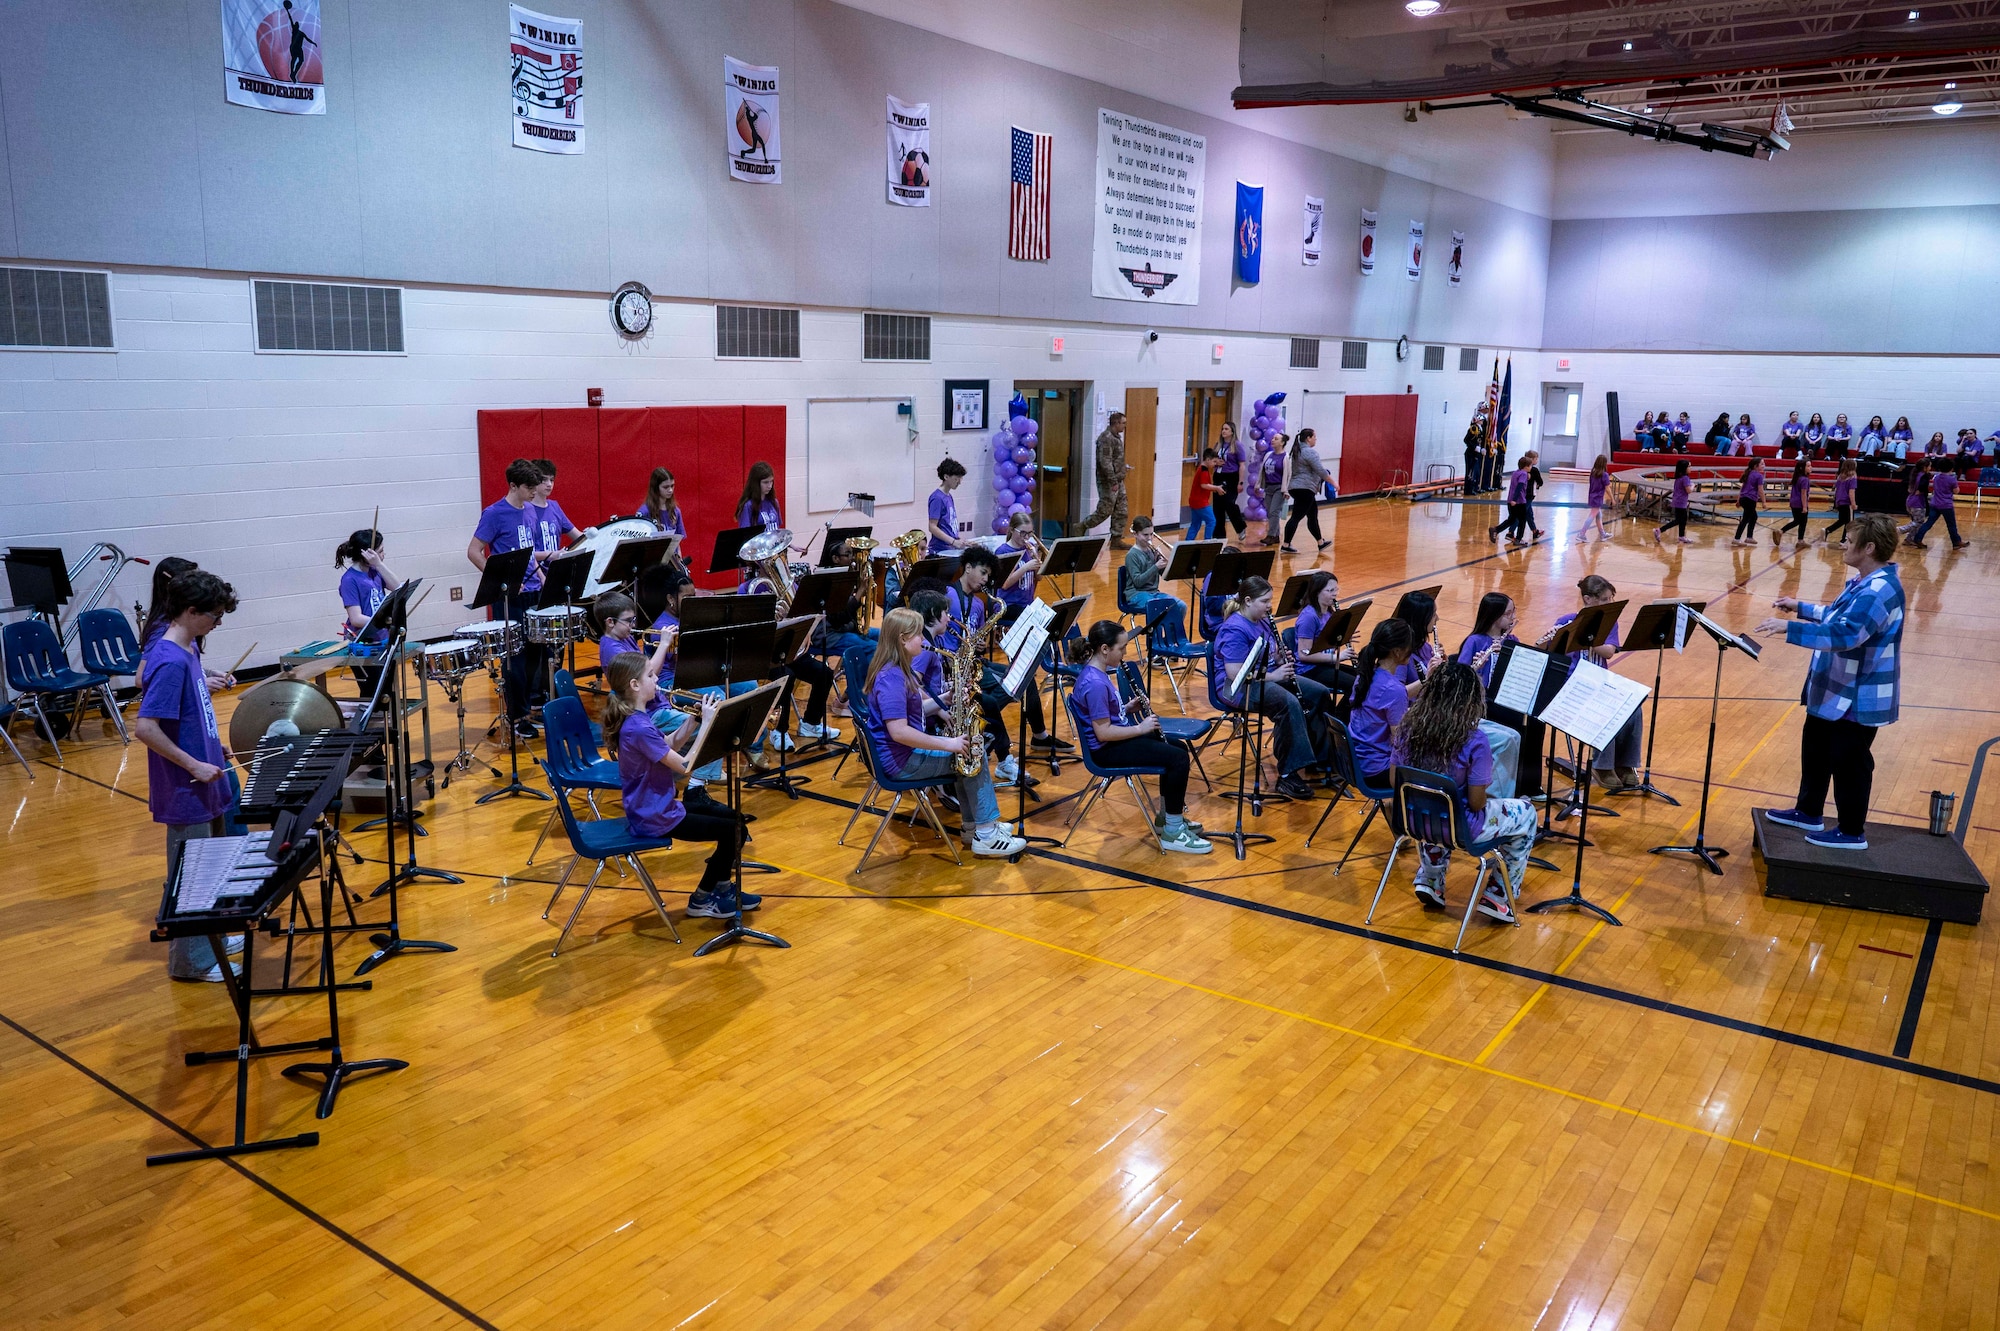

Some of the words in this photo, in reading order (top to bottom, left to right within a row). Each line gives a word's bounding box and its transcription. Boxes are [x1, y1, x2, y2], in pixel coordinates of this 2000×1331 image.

[519, 21, 577, 46] TWINING
[237, 77, 314, 101] THUNDERBIRDS
[733, 73, 776, 91] TWINING
[521, 122, 577, 142] THUNDERBIRDS
[892, 112, 927, 127] TWINING
[1103, 113, 1122, 130] Twining
[1125, 120, 1156, 137] Thunderbirds
[1159, 131, 1180, 143] awesome
[1183, 136, 1191, 146] and
[1193, 140, 1203, 149] cool
[1112, 134, 1120, 145] We
[1123, 139, 1131, 148] are
[1133, 139, 1141, 150] the
[1154, 145, 1158, 155] in
[1168, 150, 1174, 158] we
[1186, 154, 1194, 163] rule
[1118, 153, 1122, 163] In
[1125, 157, 1133, 165] our
[1136, 160, 1147, 169] work
[1150, 163, 1159, 172] and
[1161, 164, 1166, 173] in
[1168, 167, 1176, 175] our
[1177, 168, 1187, 181] play
[1108, 168, 1114, 179] We
[1117, 171, 1131, 182] strive
[1143, 178, 1168, 190] excellence
[1177, 184, 1185, 194] the
[1187, 188, 1195, 198] way
[1106, 186, 1124, 200] Always
[1127, 191, 1154, 205] determined
[1156, 197, 1167, 208] here
[1169, 200, 1173, 208] to
[1175, 202, 1195, 212] succeed
[1105, 204, 1114, 214] Our
[1116, 207, 1133, 218] school
[1145, 212, 1161, 225] always
[1163, 215, 1169, 225] be
[1170, 216, 1174, 225] in
[1186, 219, 1195, 229] lead
[1113, 224, 1120, 234] Be
[1128, 227, 1143, 238] model
[1145, 230, 1152, 239] do
[1154, 233, 1164, 242] your
[1166, 234, 1176, 243] best
[1178, 237, 1187, 246] yes
[1116, 242, 1148, 255] Thunderbirds
[1151, 248, 1162, 258] pass
[1173, 251, 1183, 260] test
